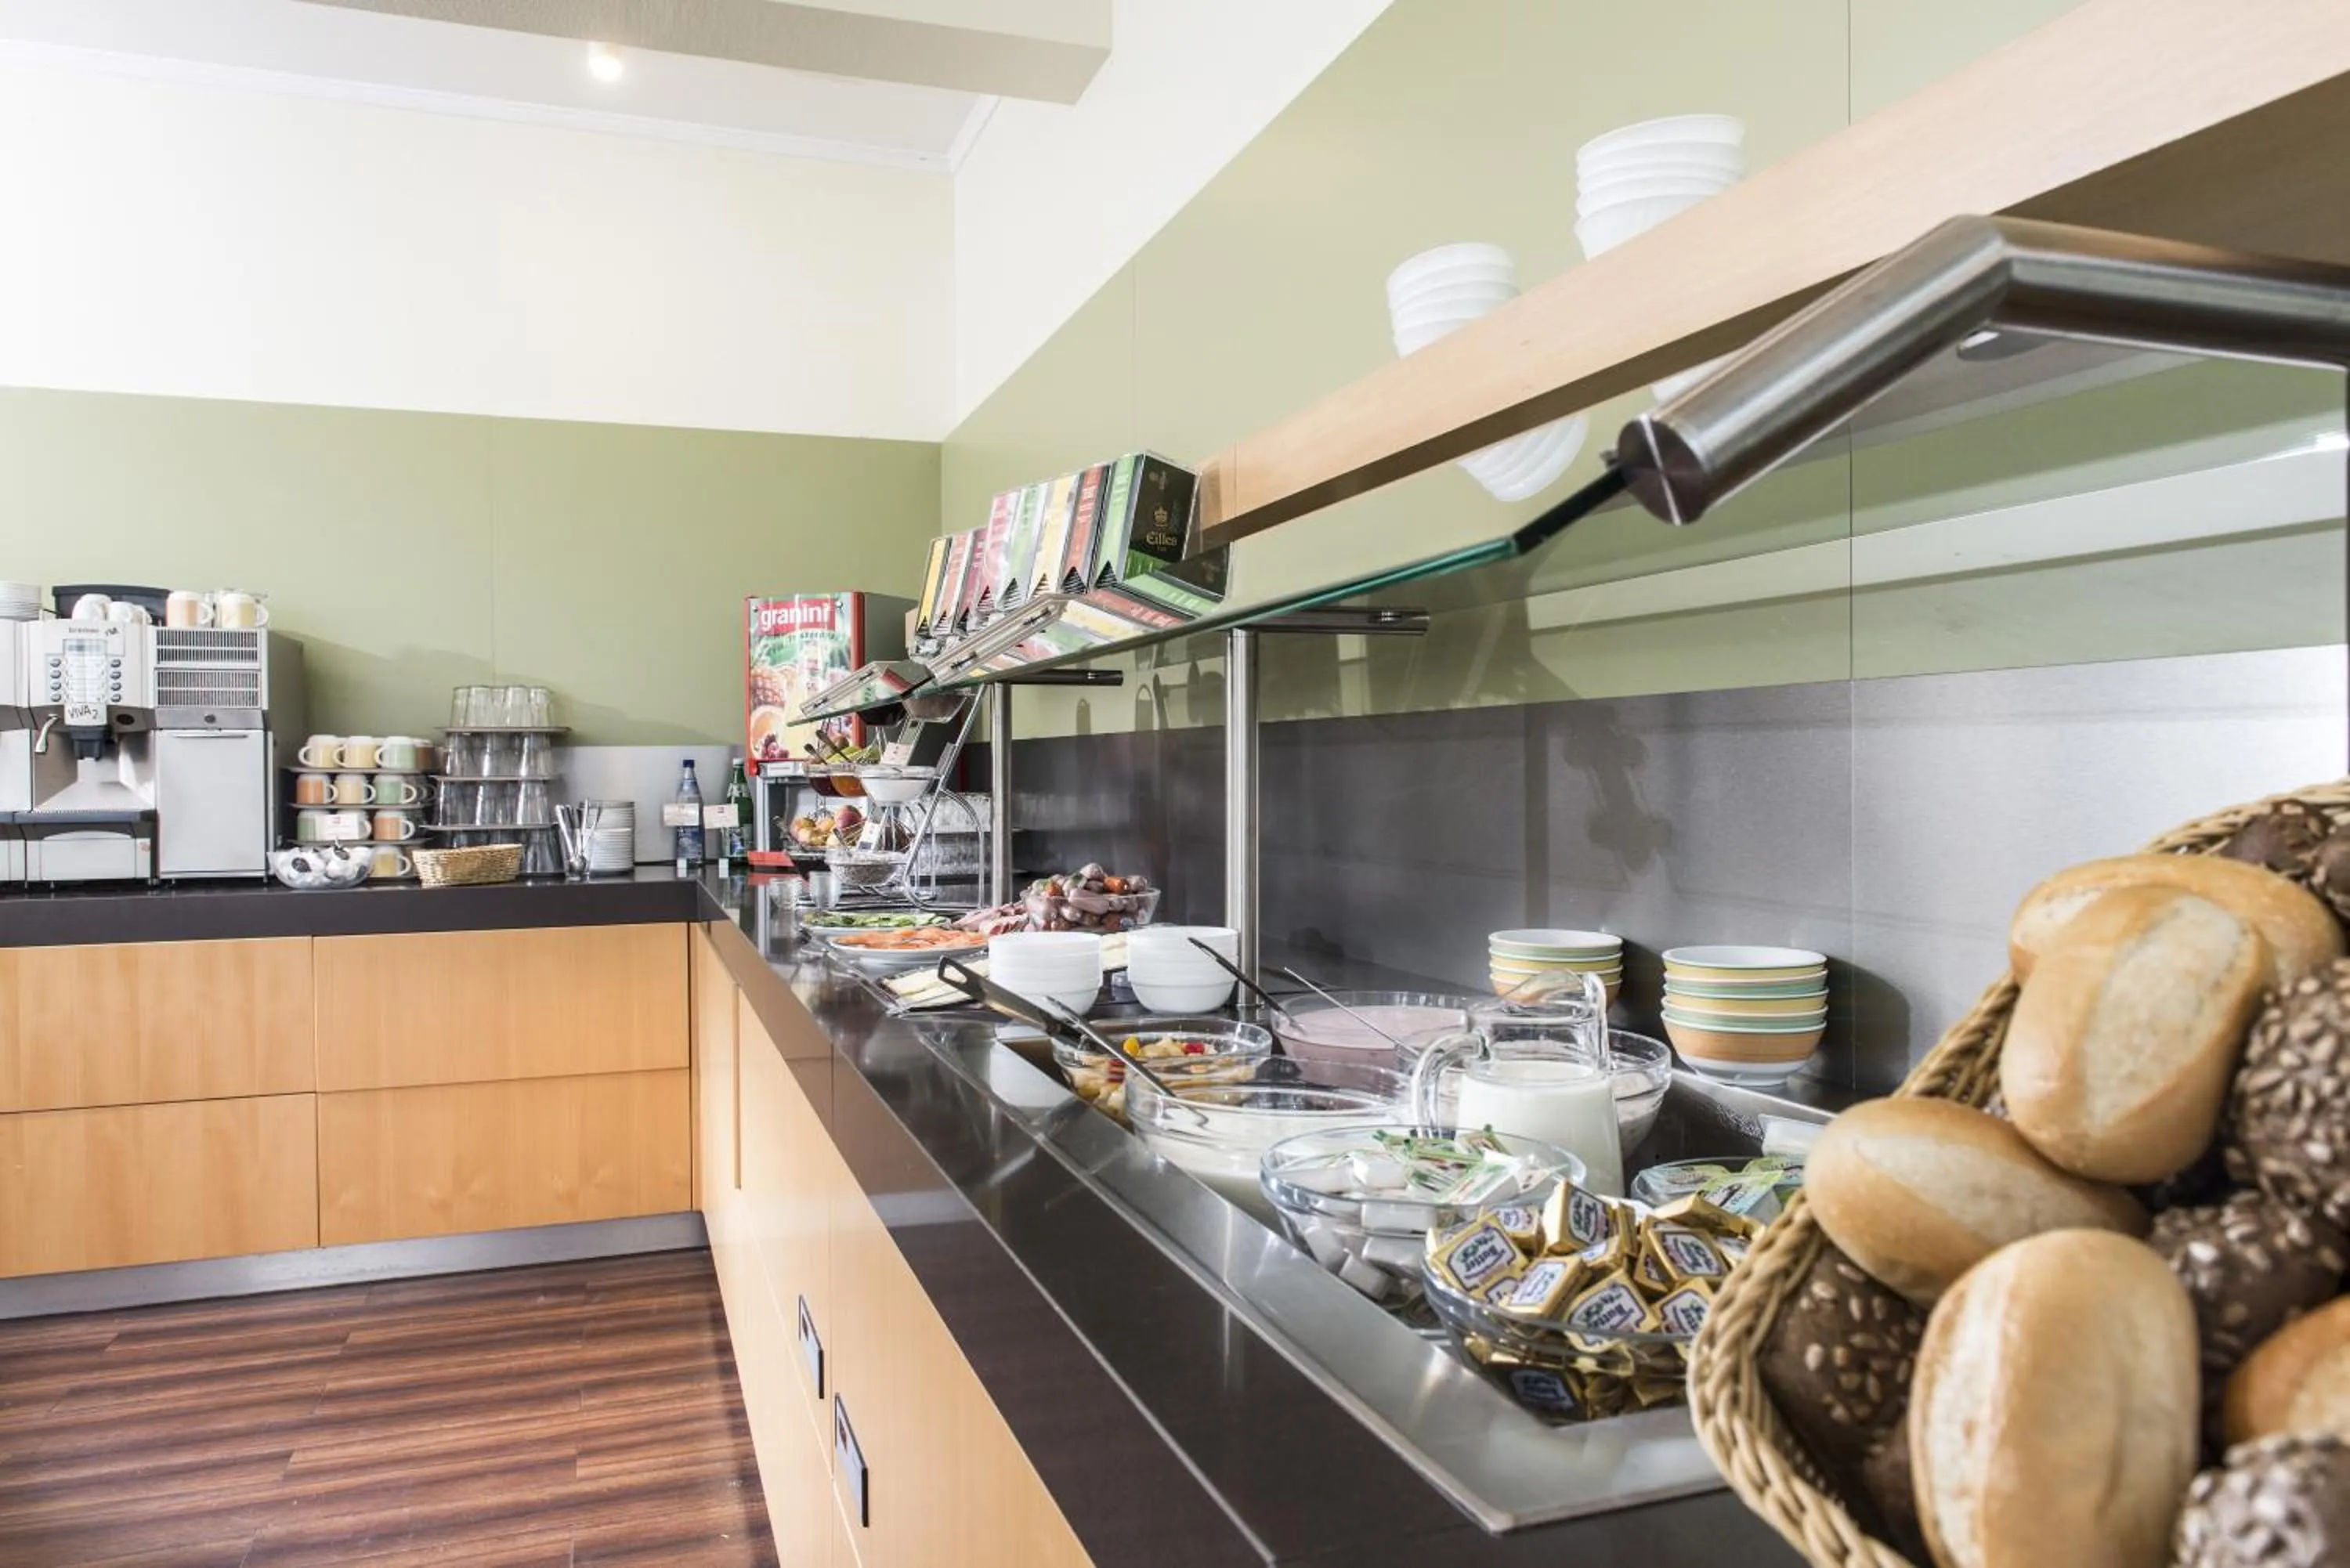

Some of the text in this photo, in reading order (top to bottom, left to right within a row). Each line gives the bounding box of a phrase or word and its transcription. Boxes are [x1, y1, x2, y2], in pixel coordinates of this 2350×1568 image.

[761, 602, 829, 631] granini
[67, 705, 92, 719] VIVA
[1464, 1244, 1499, 1273] Butter
